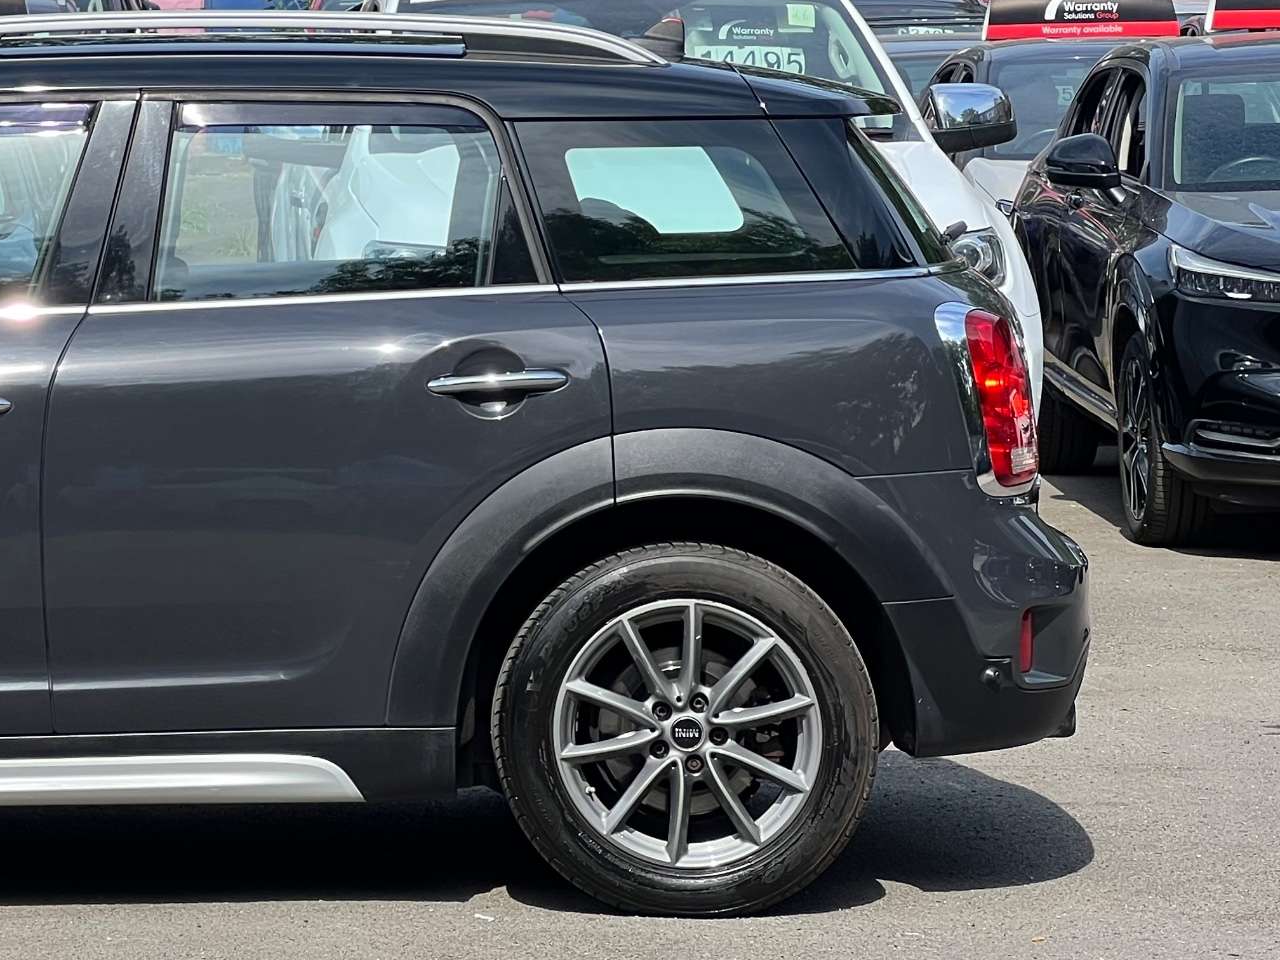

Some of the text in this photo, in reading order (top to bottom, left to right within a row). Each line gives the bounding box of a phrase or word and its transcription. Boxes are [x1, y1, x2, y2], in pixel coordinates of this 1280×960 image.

[1063, 1, 1119, 13] Warranty
[1063, 12, 1119, 20] Solutions Group
[732, 27, 774, 36] Warranty
[1042, 24, 1124, 36] Warranty available
[675, 727, 699, 738] MINI
